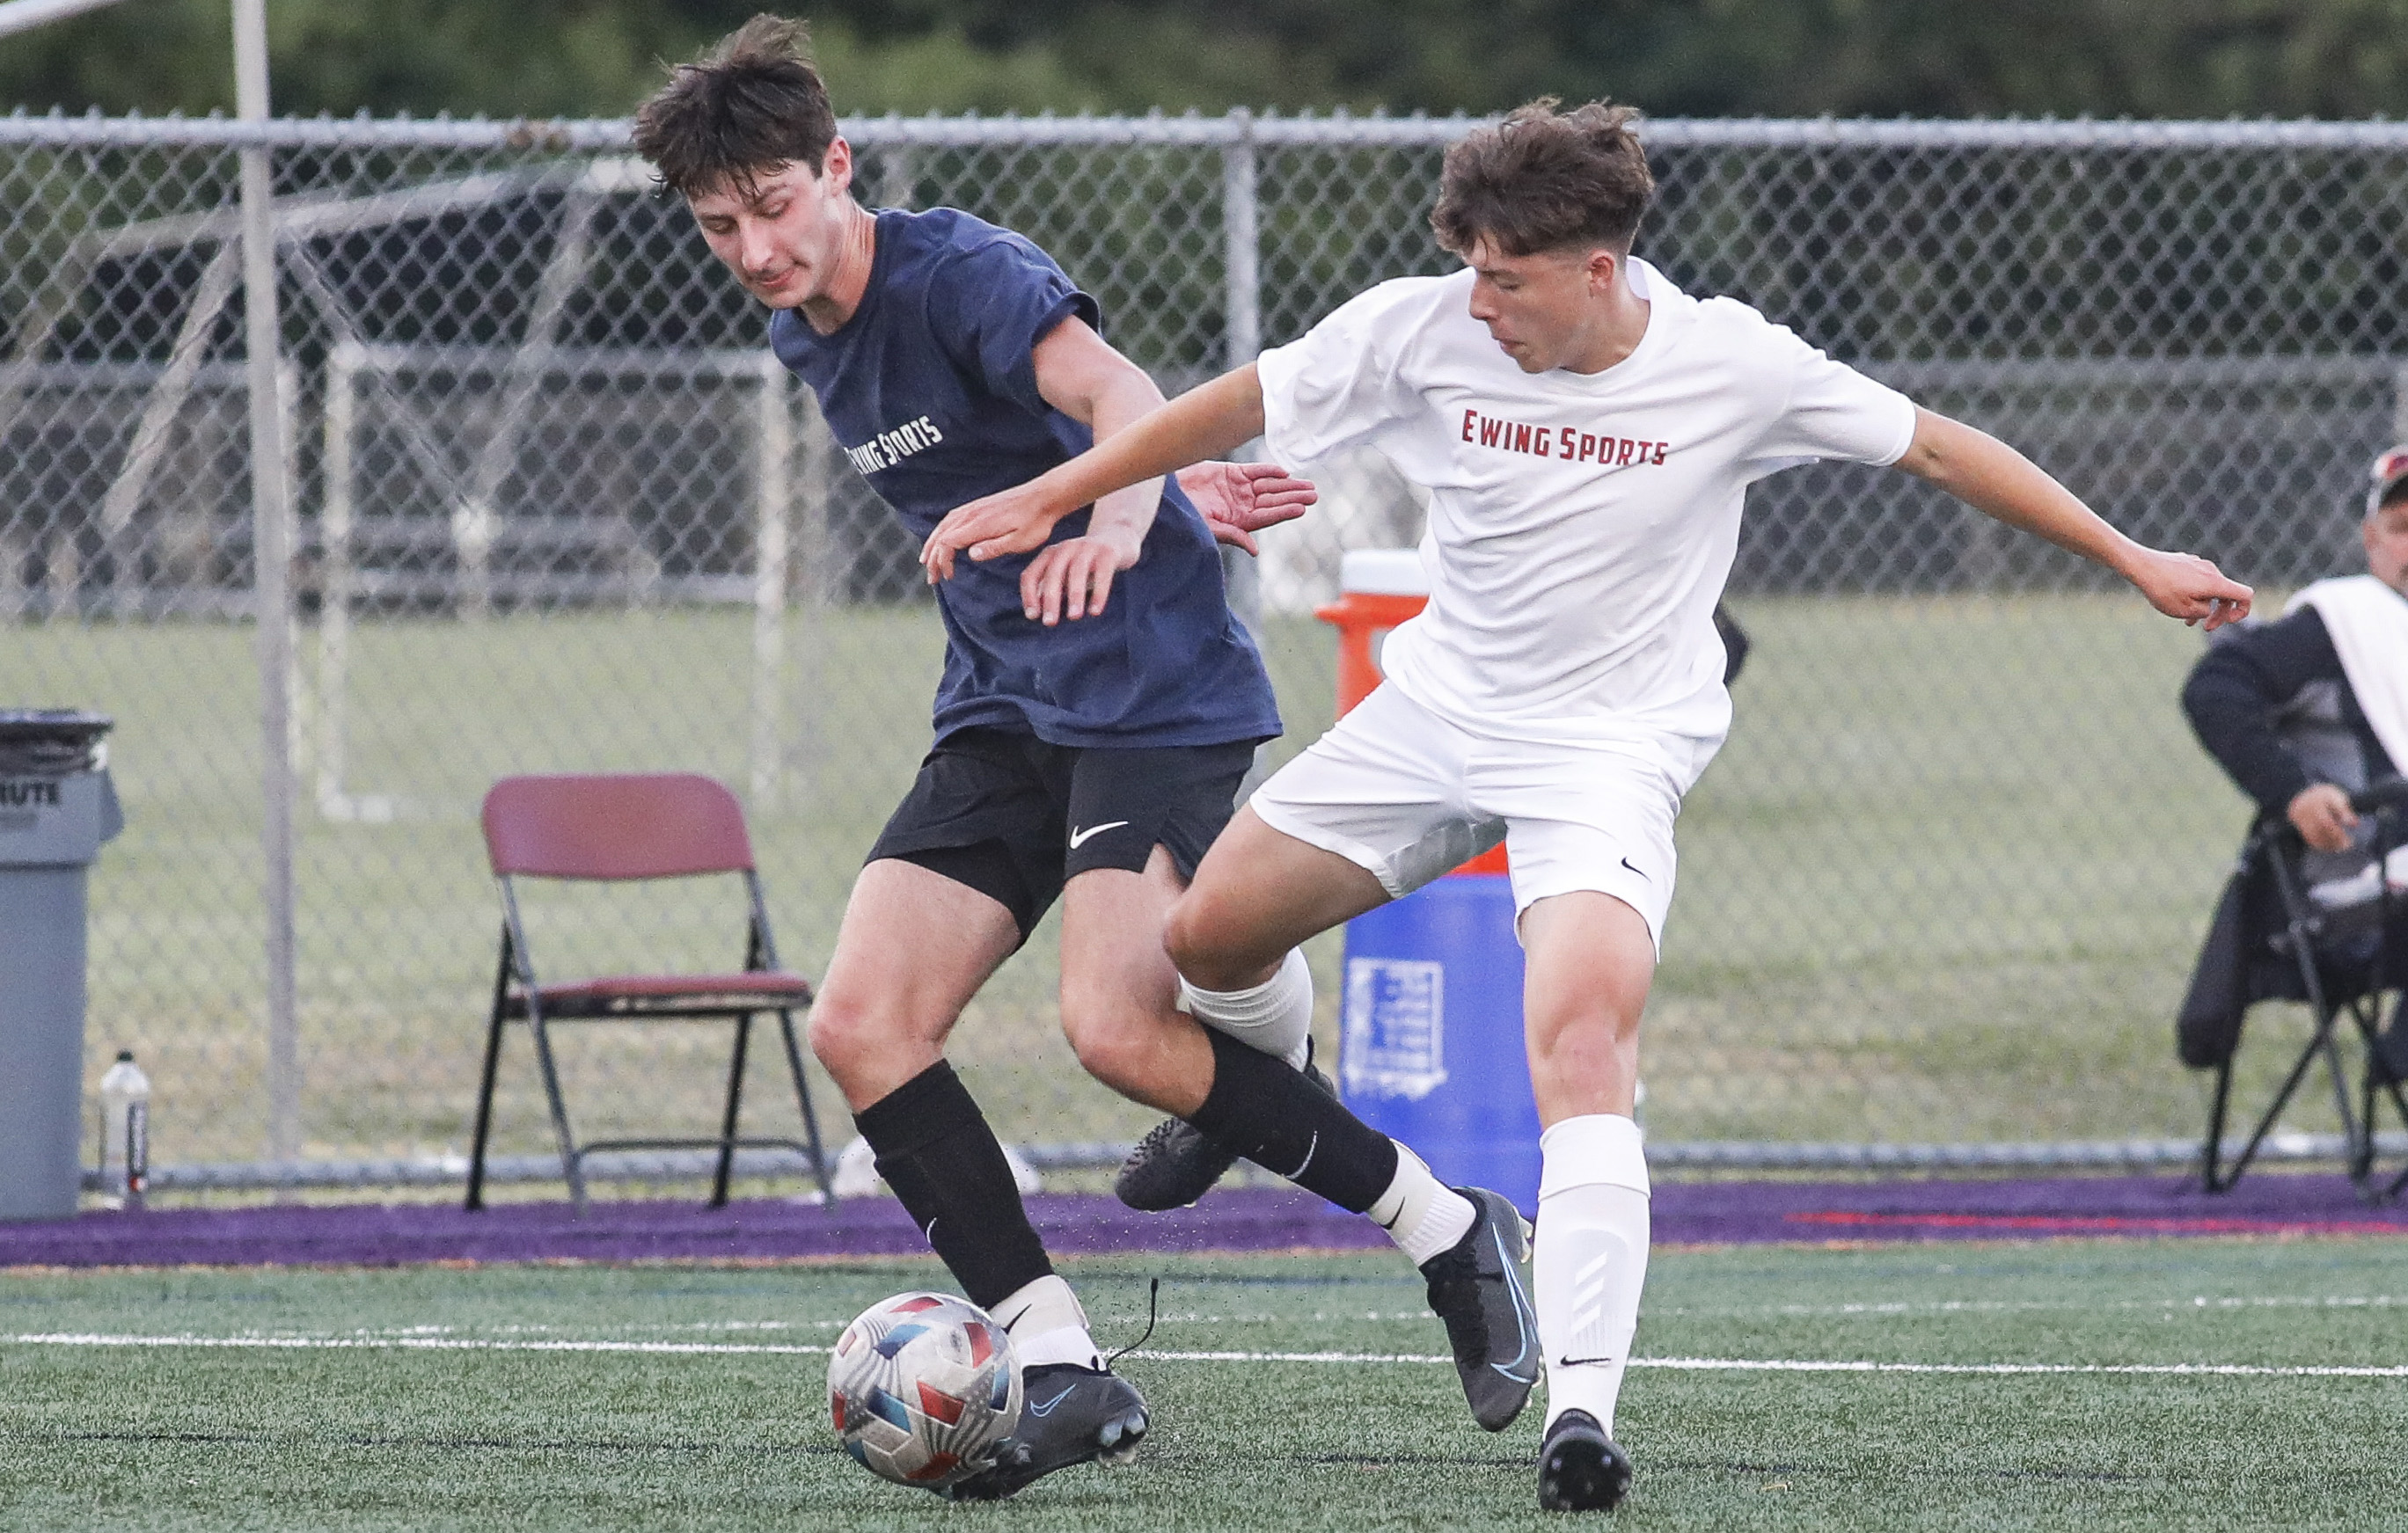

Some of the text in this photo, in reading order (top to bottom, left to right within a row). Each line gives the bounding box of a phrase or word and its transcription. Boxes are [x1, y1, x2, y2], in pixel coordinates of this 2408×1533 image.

[843, 440, 888, 476] WING
[1461, 409, 1669, 466] EWING SPORTS
